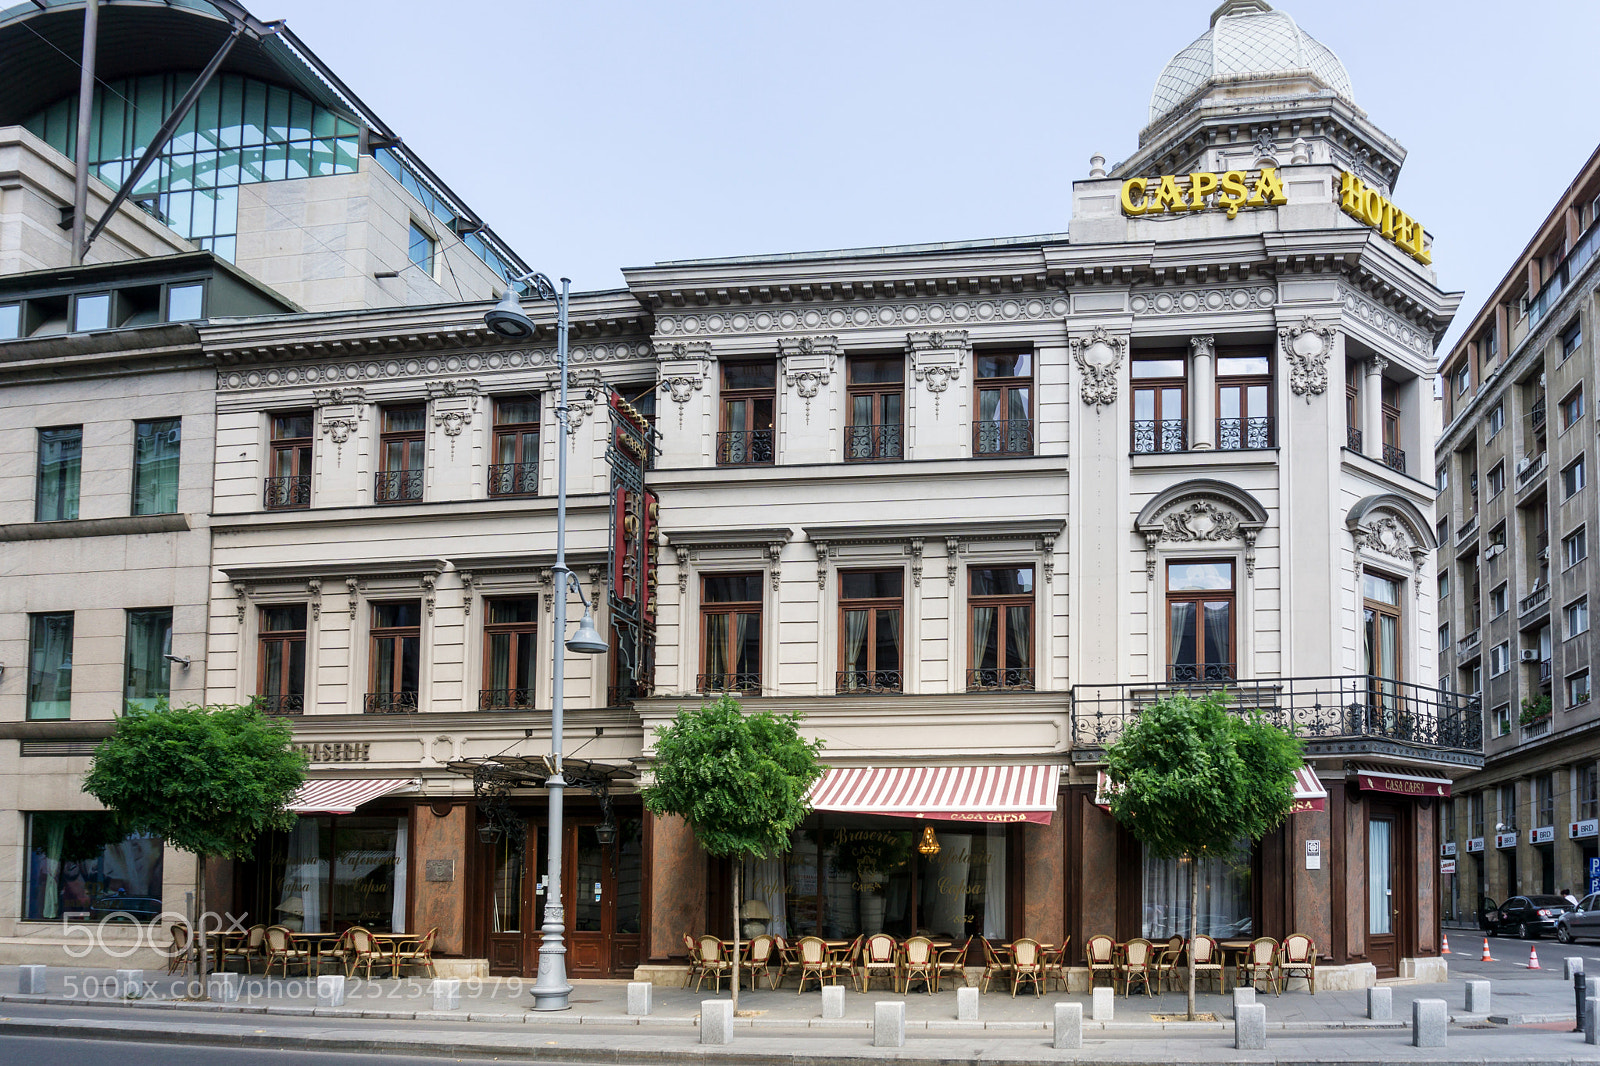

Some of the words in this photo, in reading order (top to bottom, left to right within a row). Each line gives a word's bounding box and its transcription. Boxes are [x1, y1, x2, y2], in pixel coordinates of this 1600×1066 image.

[1340, 171, 1432, 265] HOTEL
[1385, 780, 1403, 792] CASA
[1404, 781, 1425, 794] CAPSA
[1289, 800, 1314, 812] PSA
[1580, 824, 1594, 832] BRD
[1539, 830, 1551, 838] BRD
[851, 845, 882, 856] CASA
